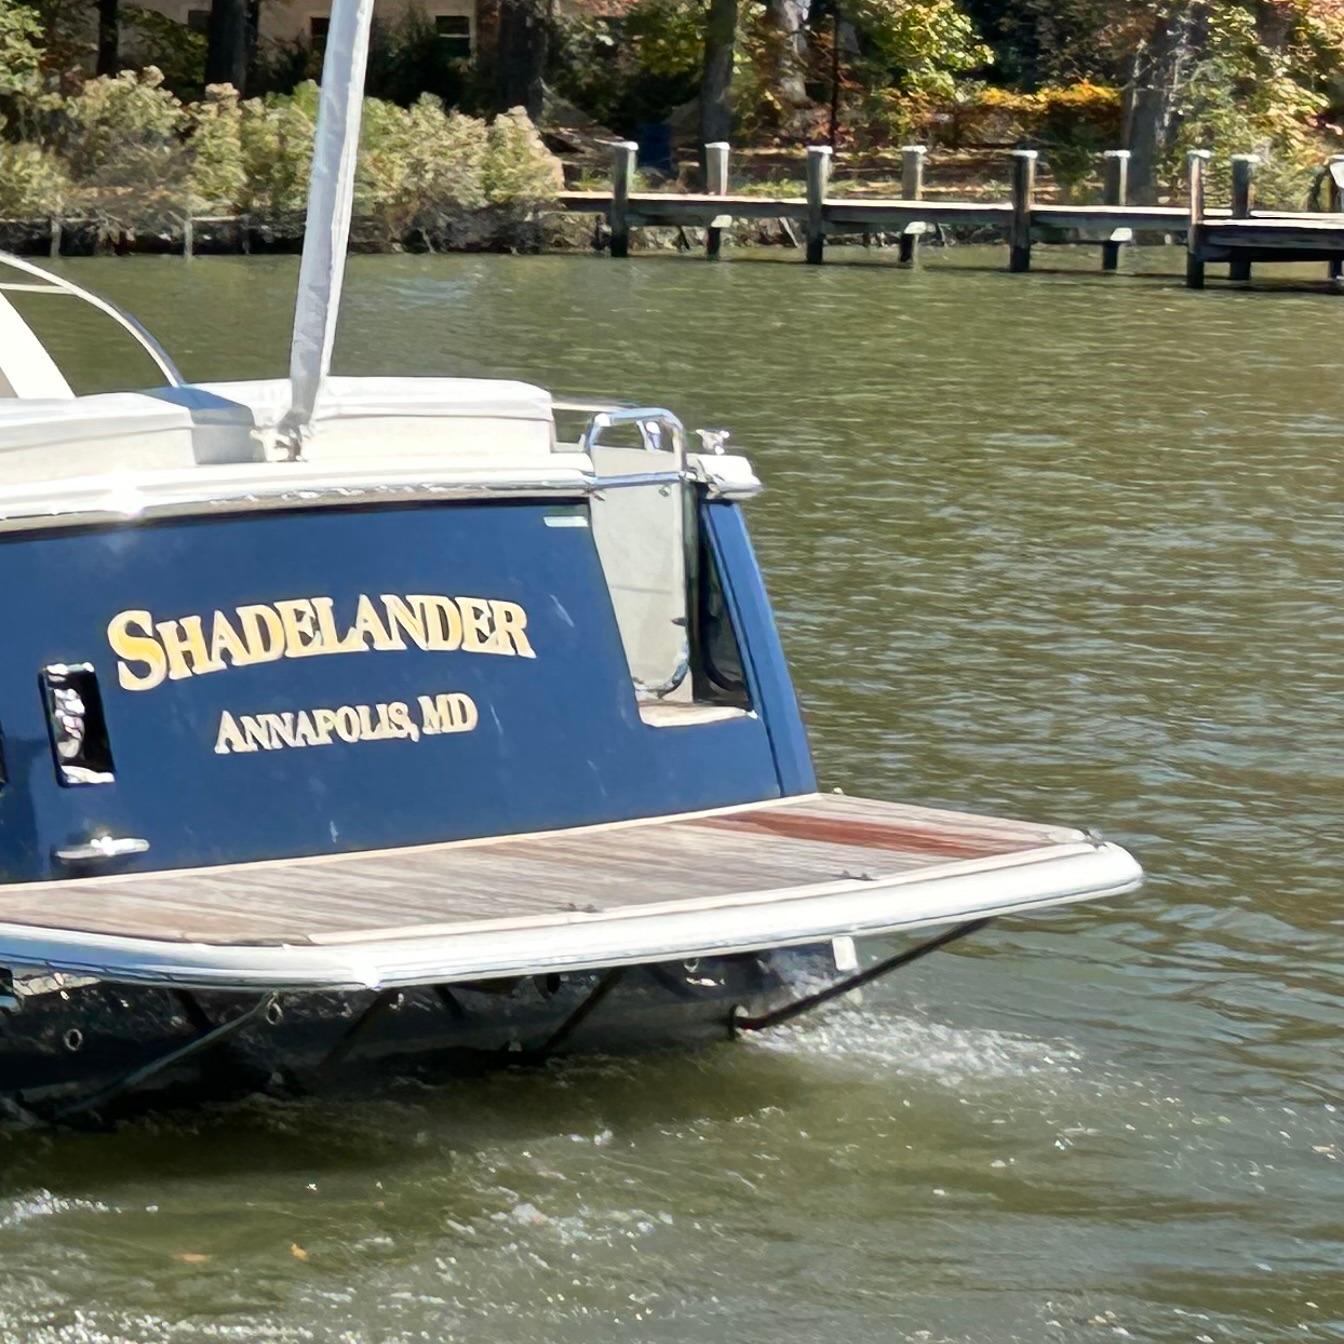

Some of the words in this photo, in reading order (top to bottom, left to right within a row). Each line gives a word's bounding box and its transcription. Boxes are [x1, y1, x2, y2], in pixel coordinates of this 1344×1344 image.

[107, 594, 536, 691] SHADELANDER
[215, 702, 420, 754] ANNAPOLIS,
[420, 693, 478, 735] MD
